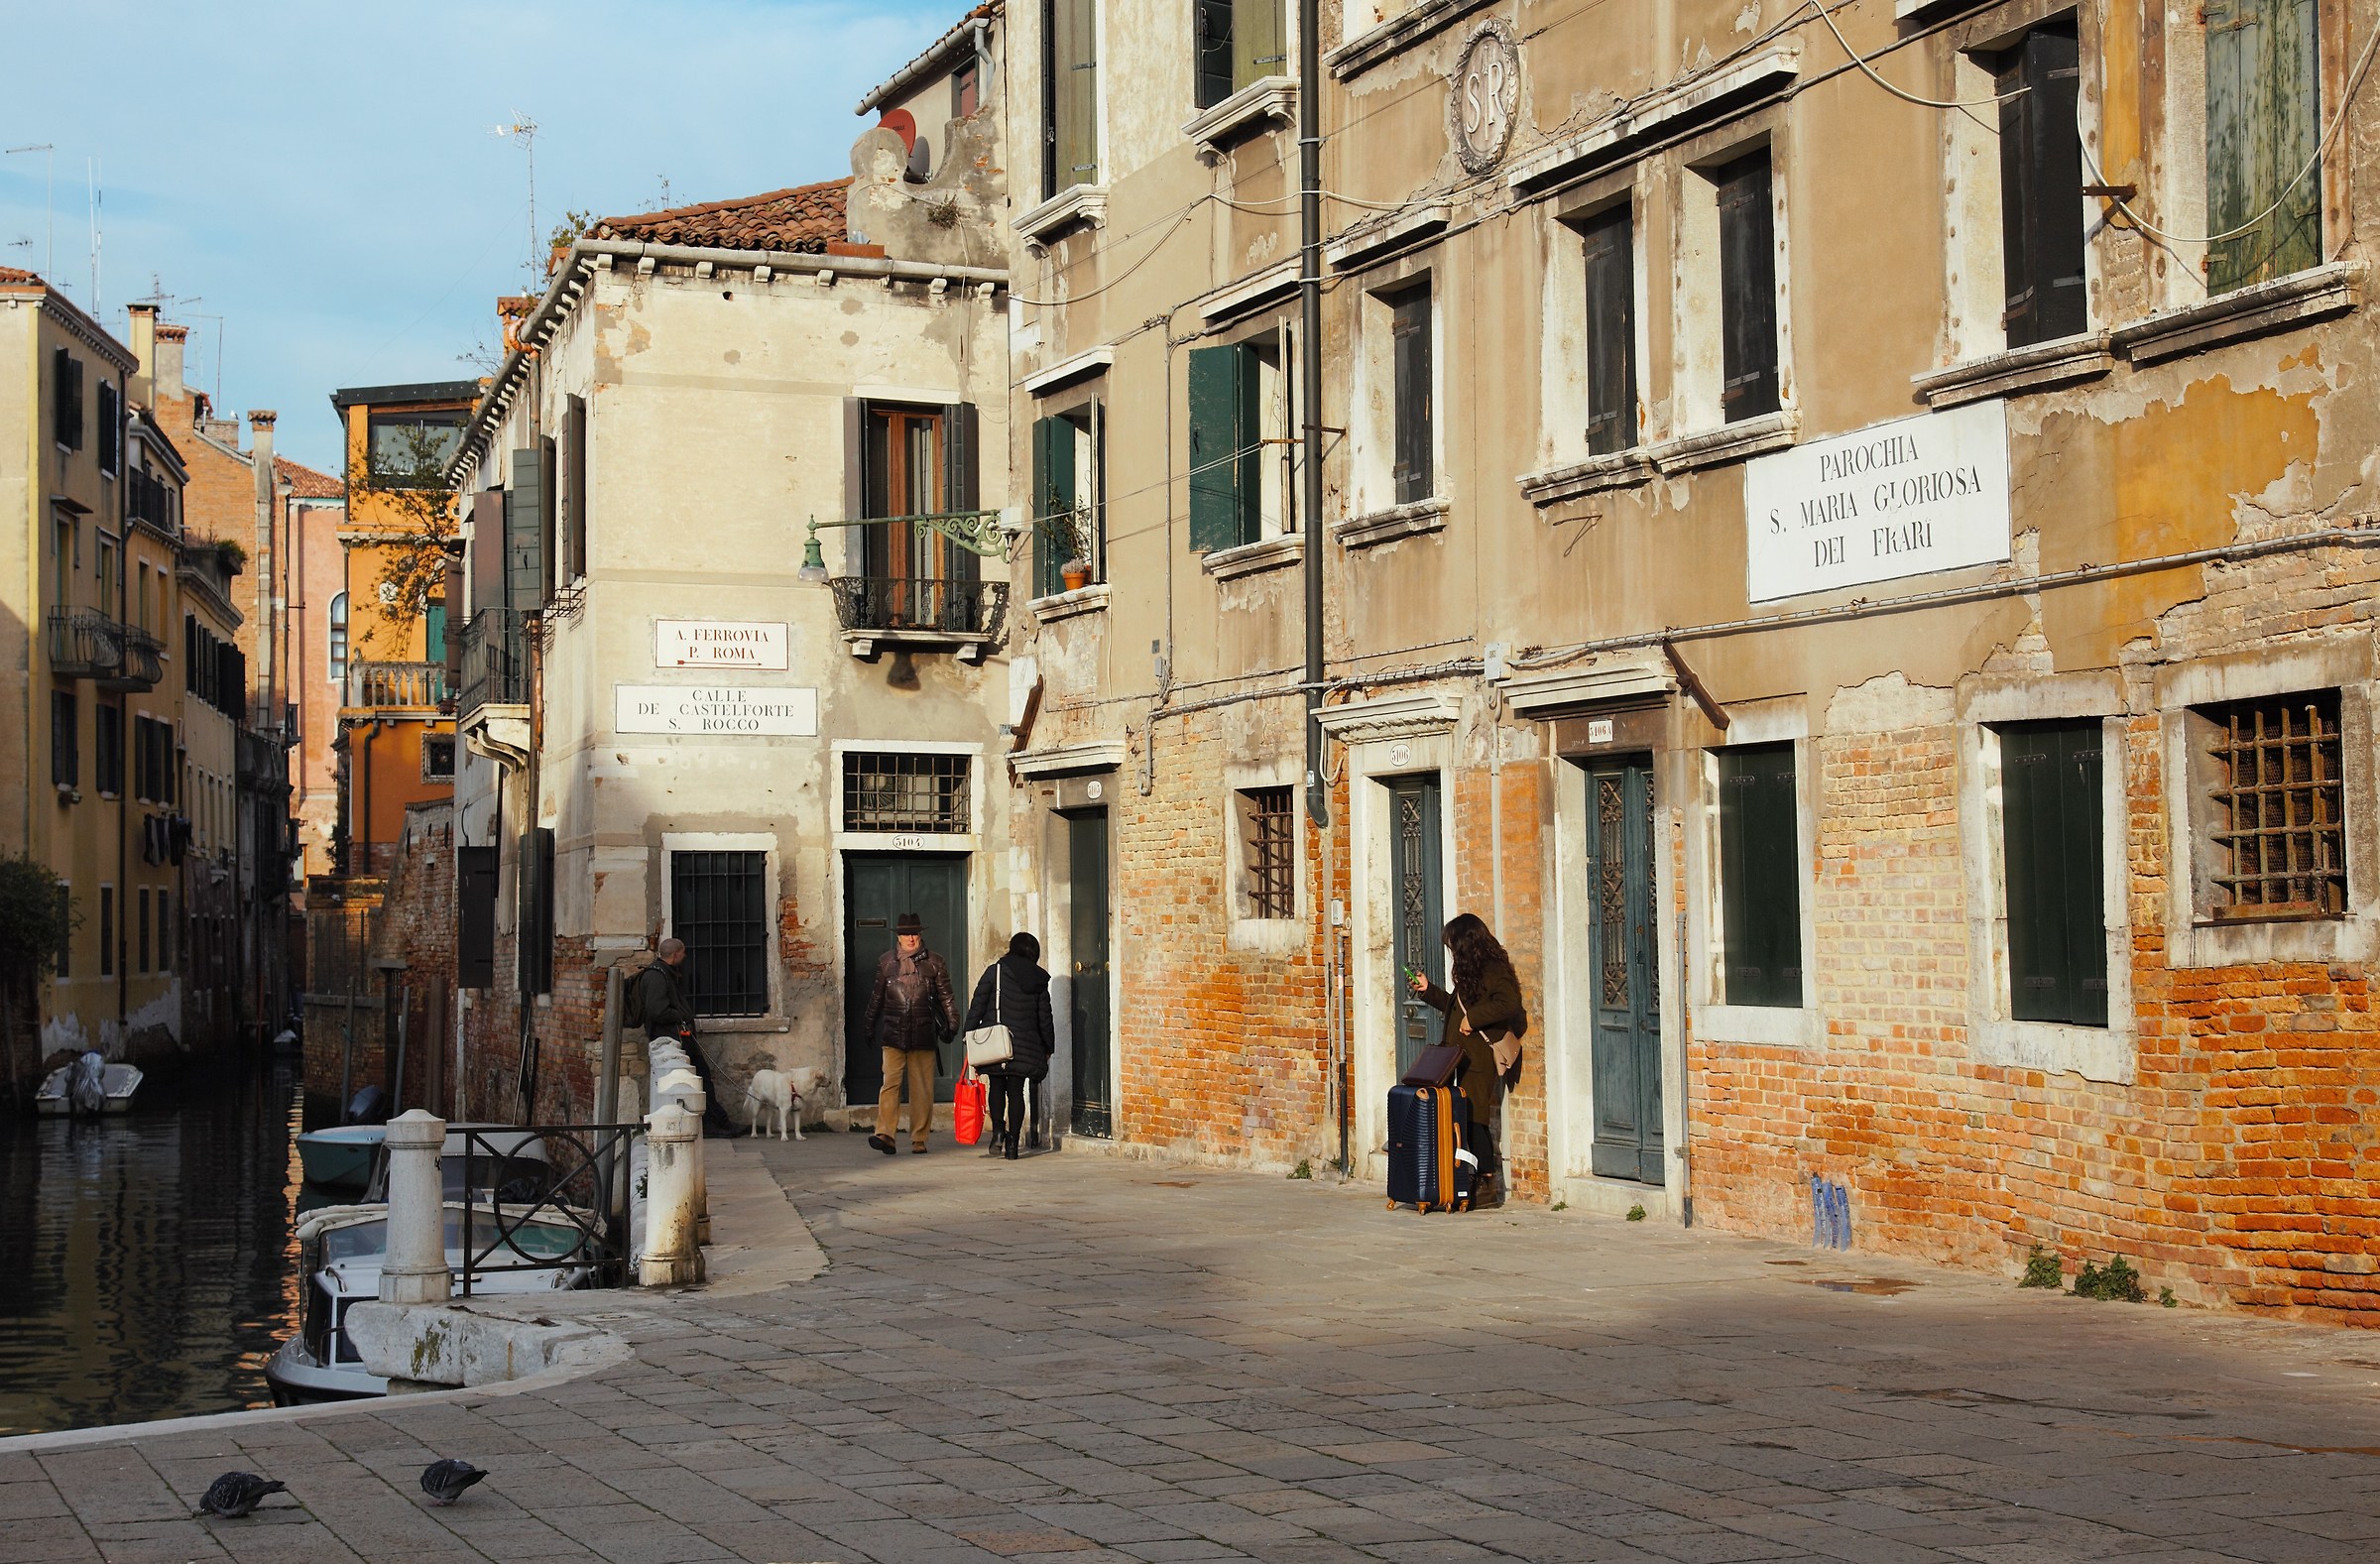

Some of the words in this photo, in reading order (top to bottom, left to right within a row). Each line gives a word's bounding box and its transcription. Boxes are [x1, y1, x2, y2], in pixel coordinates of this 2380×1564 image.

[1820, 433, 1919, 483] PAROCHIA
[1770, 508, 1787, 535] S.
[1801, 491, 1858, 529] MARIA
[1873, 464, 1982, 512] GLORIOSA
[1814, 536, 1845, 568] DEI
[1872, 519, 1933, 557] FRARI
[675, 630, 687, 641] A.
[694, 629, 769, 643] FERROVIA
[689, 647, 699, 659] P.
[713, 647, 755, 660] ROMA
[692, 690, 747, 702] CALLE
[639, 703, 659, 715] DE
[679, 704, 794, 717] CASTELFORTE
[668, 718, 681, 730] S.
[703, 719, 759, 731] ROCCO
[1391, 750, 1409, 762] 5106
[895, 838, 921, 847] 5104
